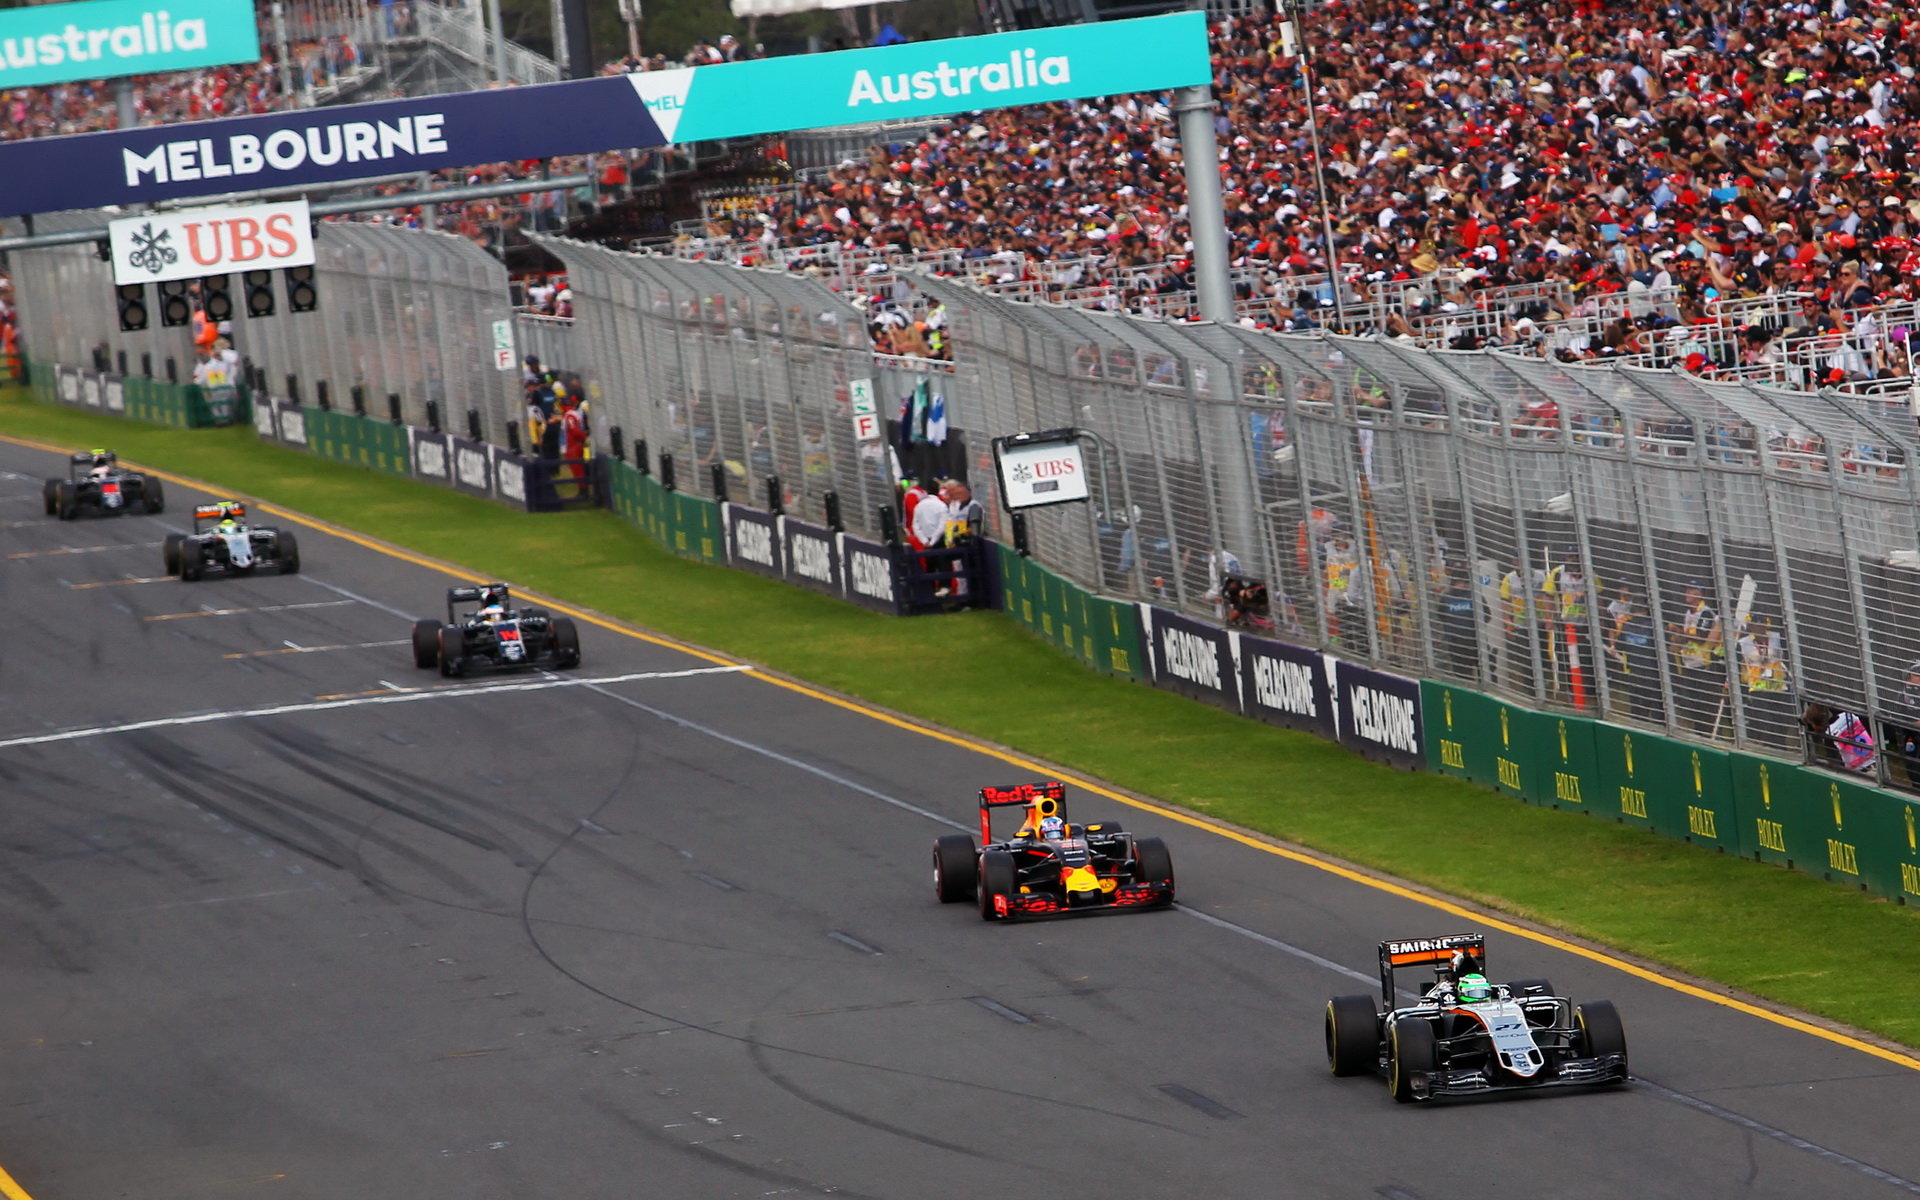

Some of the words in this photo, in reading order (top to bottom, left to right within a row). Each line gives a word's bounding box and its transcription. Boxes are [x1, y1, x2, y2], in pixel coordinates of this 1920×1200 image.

[0, 10, 208, 71] ustralia
[847, 47, 1071, 107] Australia
[123, 114, 448, 187] MELBOURNE
[182, 213, 298, 266] UBS
[859, 417, 872, 437] F
[1034, 457, 1075, 478] UBS
[1162, 627, 1222, 691] MELBOURNE
[1252, 654, 1317, 718] MELBOURNE
[1351, 683, 1418, 755] MELBOURNE
[1440, 739, 1465, 769] ROLEX
[1497, 756, 1521, 791] ROLEX
[1555, 771, 1582, 804] ROLEX
[1620, 786, 1648, 819] ROLEX
[1688, 805, 1717, 839] ROLEX
[1757, 818, 1786, 852] ROLEX
[1827, 838, 1860, 876] ROLEX
[1901, 862, 1920, 896] ROL
